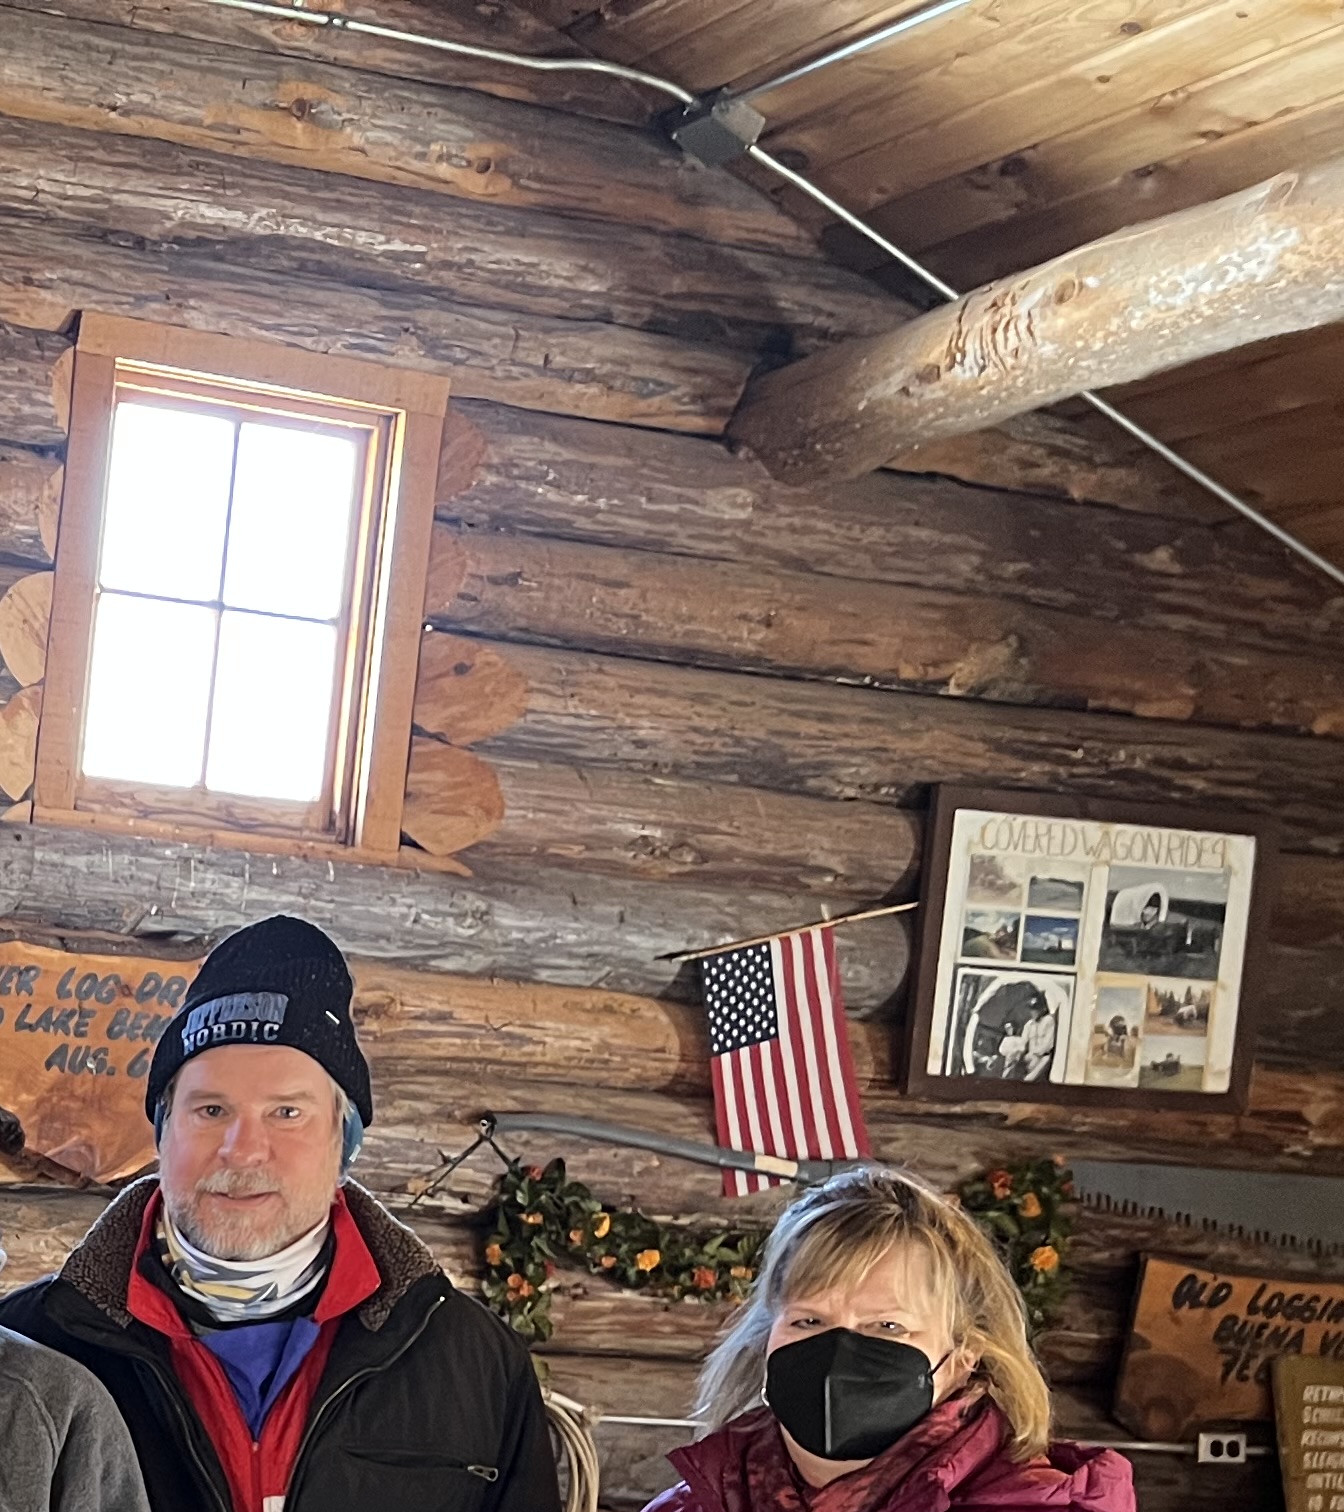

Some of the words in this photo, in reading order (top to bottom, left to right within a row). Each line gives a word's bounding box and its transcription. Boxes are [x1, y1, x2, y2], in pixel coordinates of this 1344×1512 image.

[980, 817, 1077, 856] COVERED
[1081, 826, 1163, 865] WAGON
[56, 966, 122, 1005] LOG
[14, 1003, 96, 1038] LAKE
[183, 1021, 279, 1056] NORDIC
[44, 1043, 115, 1076] AUG.
